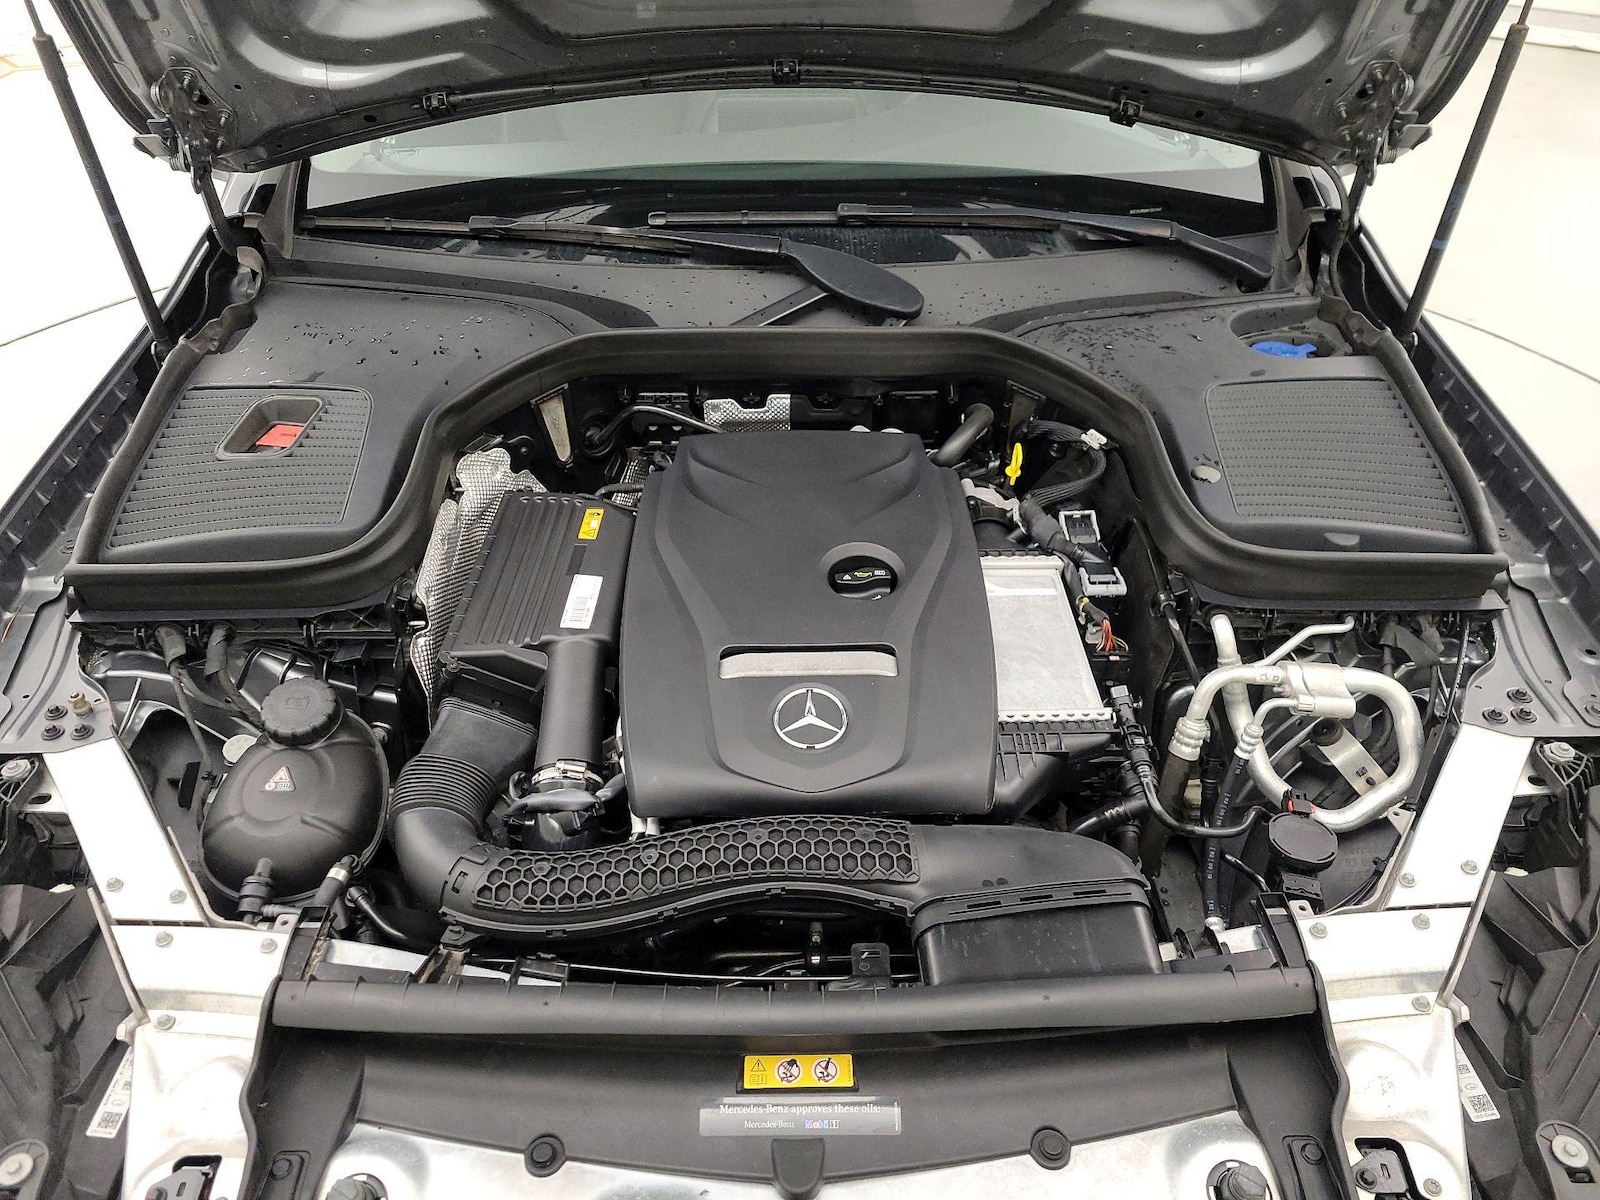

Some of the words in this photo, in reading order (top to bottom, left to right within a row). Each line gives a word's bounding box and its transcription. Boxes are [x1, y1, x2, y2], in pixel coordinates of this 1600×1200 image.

[719, 1104, 789, 1114] Mercedes-Benz
[790, 1105, 833, 1116] approves
[834, 1103, 859, 1113] these
[861, 1103, 881, 1113] oils:
[744, 1120, 796, 1129] Mercedes-Benz
